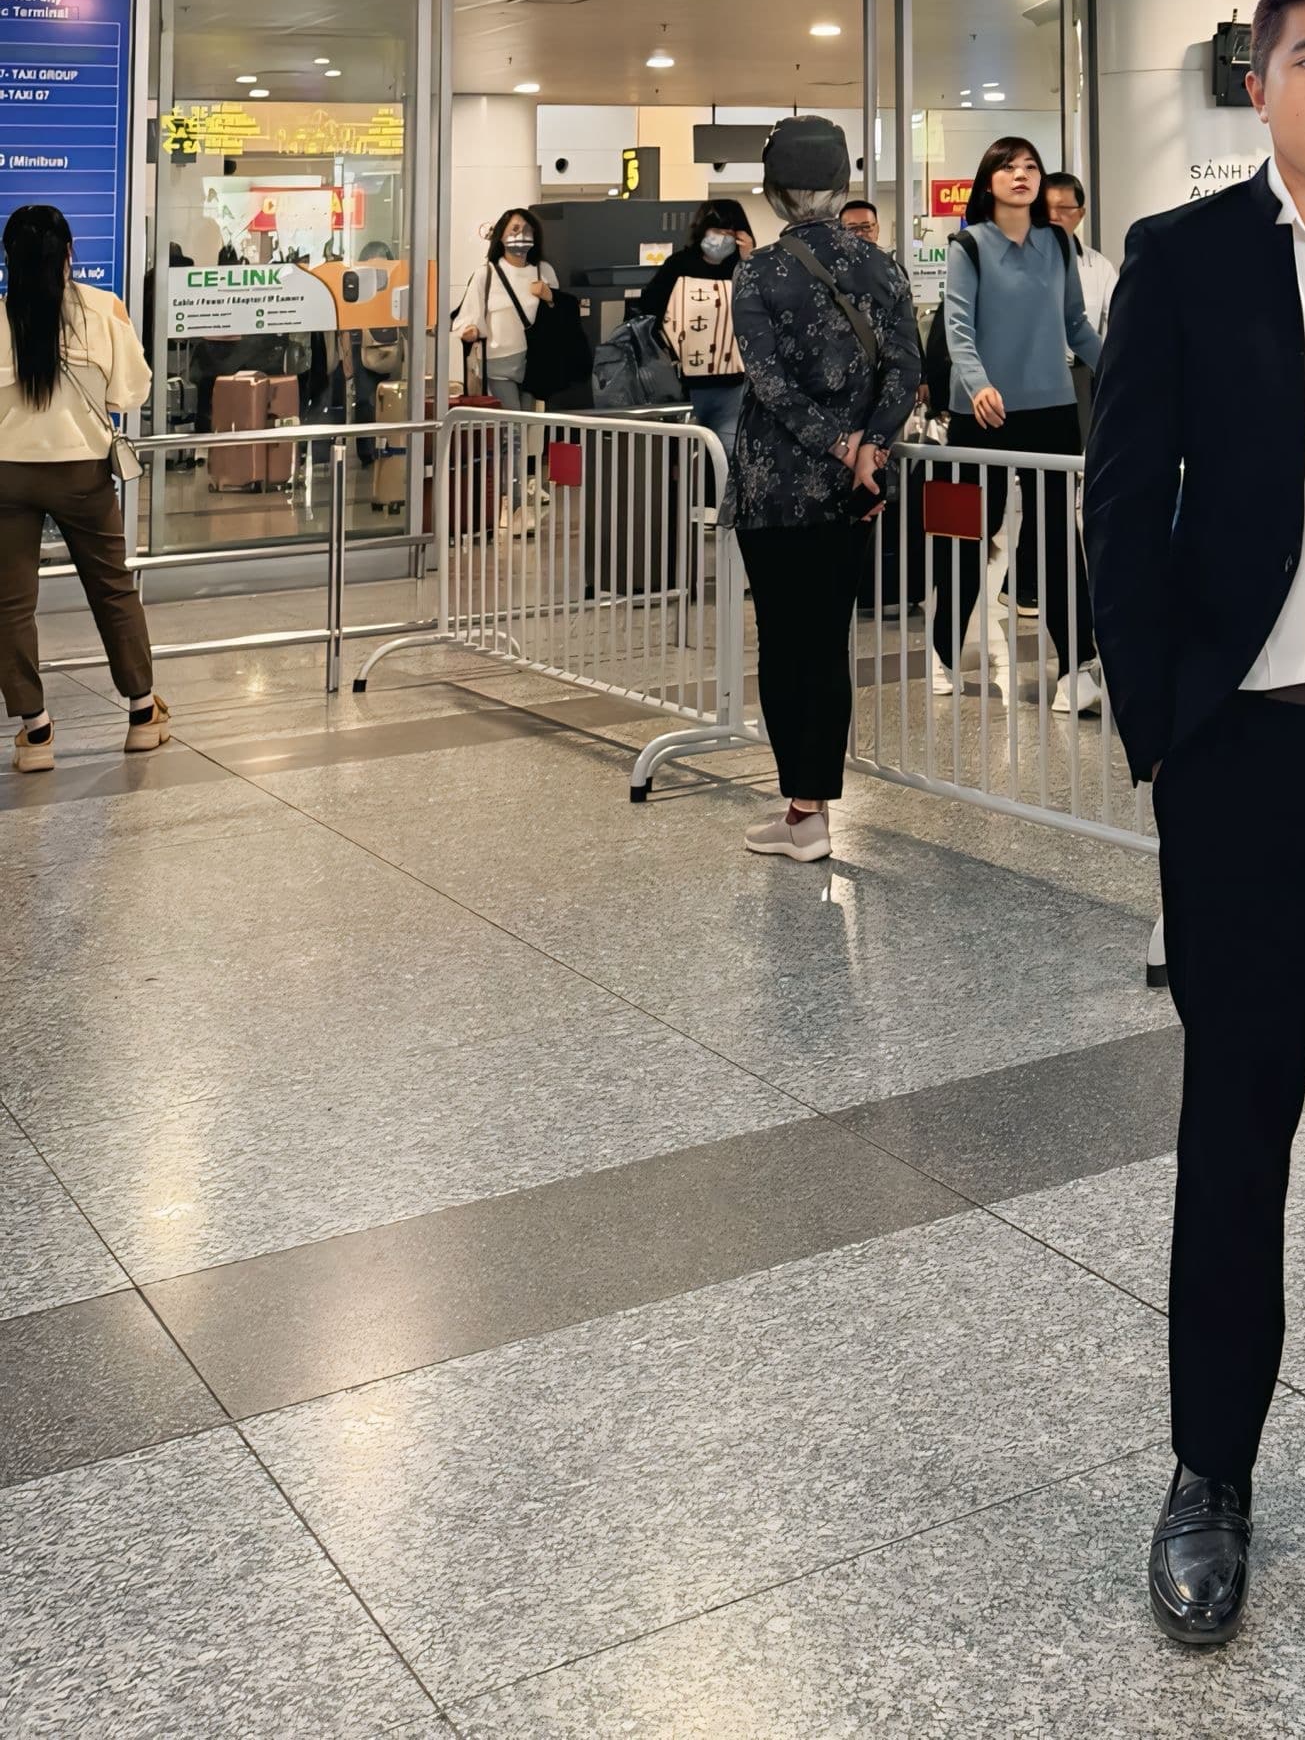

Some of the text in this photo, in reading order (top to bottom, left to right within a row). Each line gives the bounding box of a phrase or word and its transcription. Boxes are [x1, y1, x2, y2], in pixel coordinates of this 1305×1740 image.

[12, 69, 37, 80] TAXI
[39, 69, 79, 81] GROUP
[9, 155, 69, 169] (Minibus)
[187, 269, 282, 288] CE-LINK
